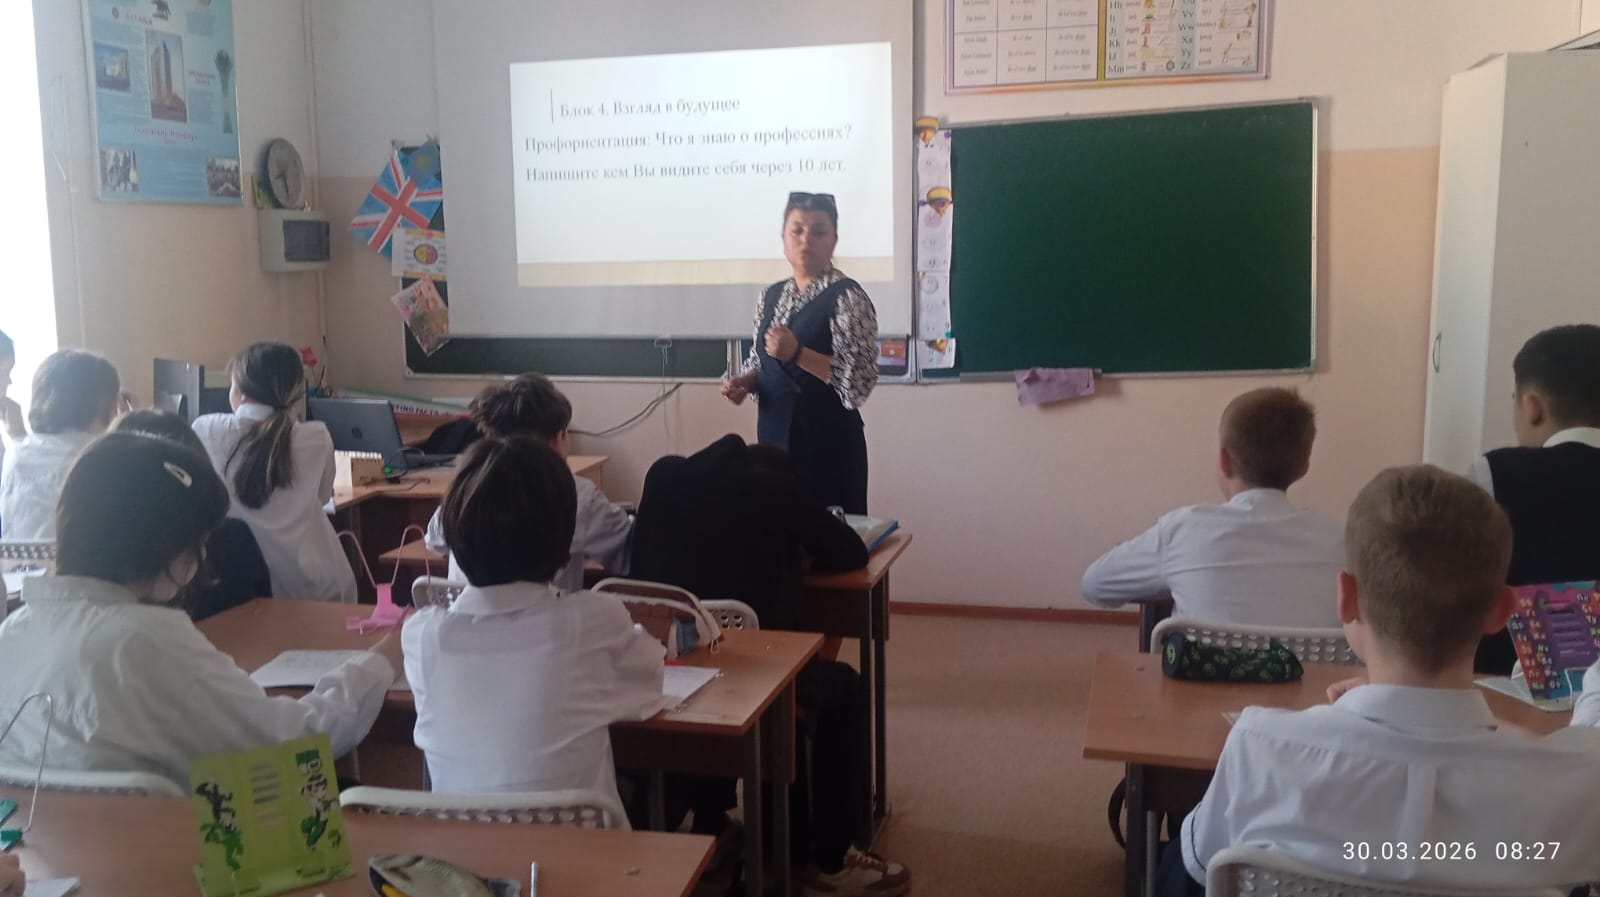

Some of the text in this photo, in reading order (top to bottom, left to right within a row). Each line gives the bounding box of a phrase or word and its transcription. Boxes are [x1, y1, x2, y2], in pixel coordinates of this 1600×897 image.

[560, 98, 741, 118] Блок 4. Взгляд в будущее
[525, 123, 852, 154] Профориентация: Что я знаю о профессиях?
[526, 157, 847, 182] Напишите кем Вы видите себя через 10 лет.
